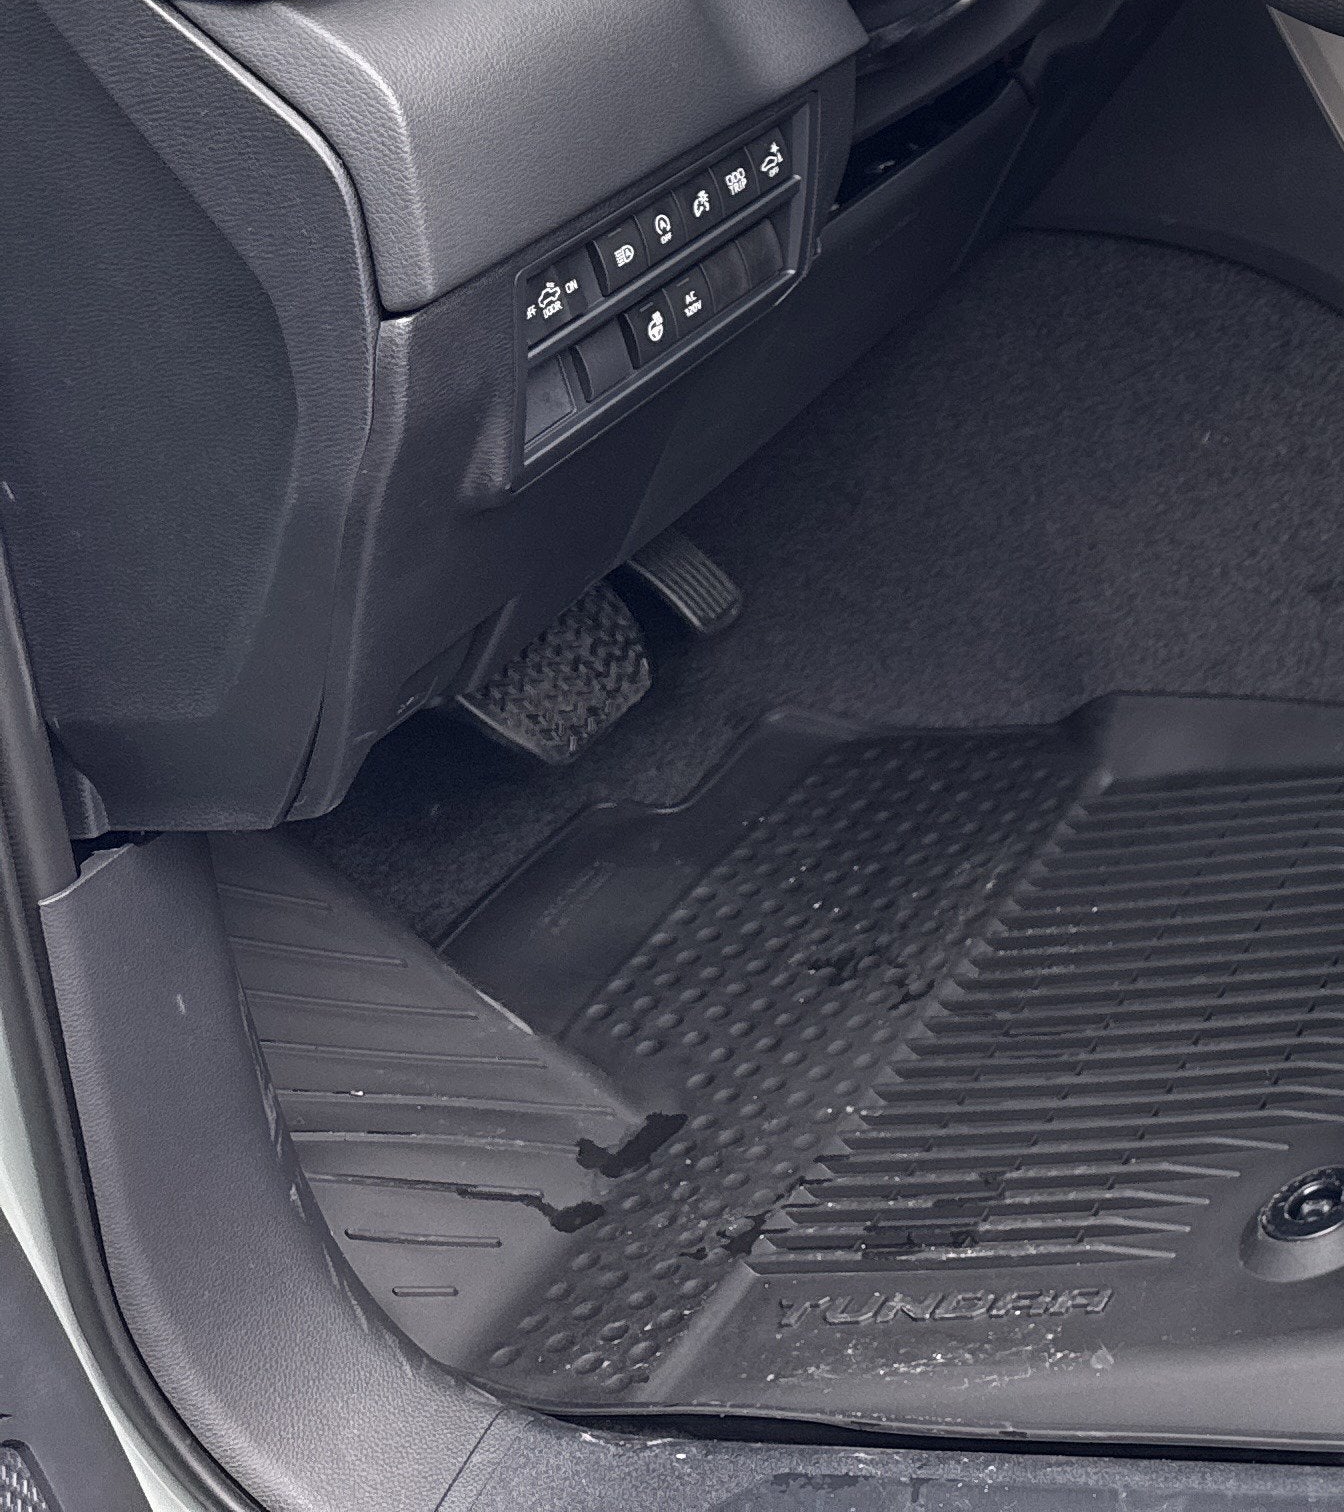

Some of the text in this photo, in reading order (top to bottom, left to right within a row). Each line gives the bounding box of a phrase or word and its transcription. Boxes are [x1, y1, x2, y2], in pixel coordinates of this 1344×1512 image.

[728, 177, 748, 196] TRIP
[565, 278, 579, 294] ON
[685, 290, 698, 305] AC
[542, 300, 563, 319] DOOR
[779, 1288, 1114, 1328] TUNDRA
